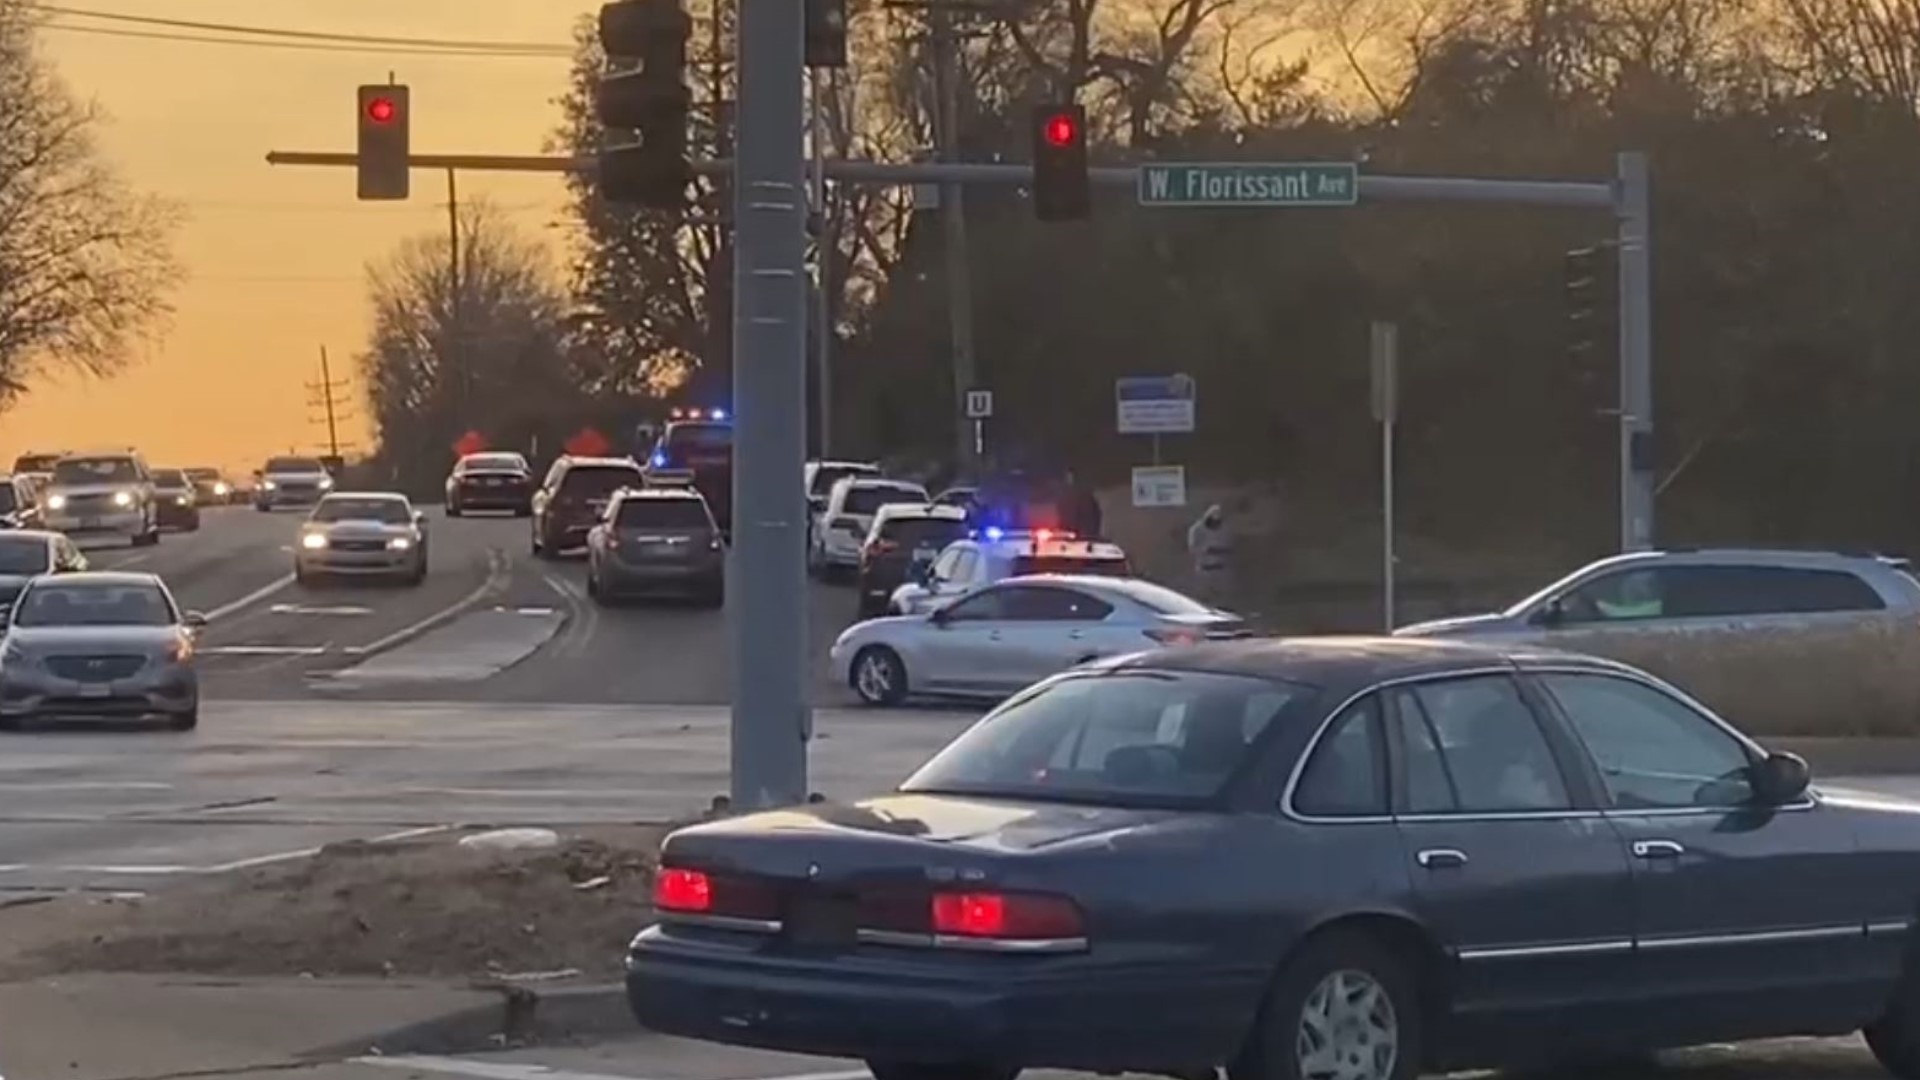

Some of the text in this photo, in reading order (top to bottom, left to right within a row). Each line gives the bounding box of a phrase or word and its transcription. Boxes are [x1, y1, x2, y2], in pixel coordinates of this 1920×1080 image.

[1187, 169, 1309, 199] Florissant
[1318, 174, 1346, 193] Ave
[973, 395, 986, 413] U
